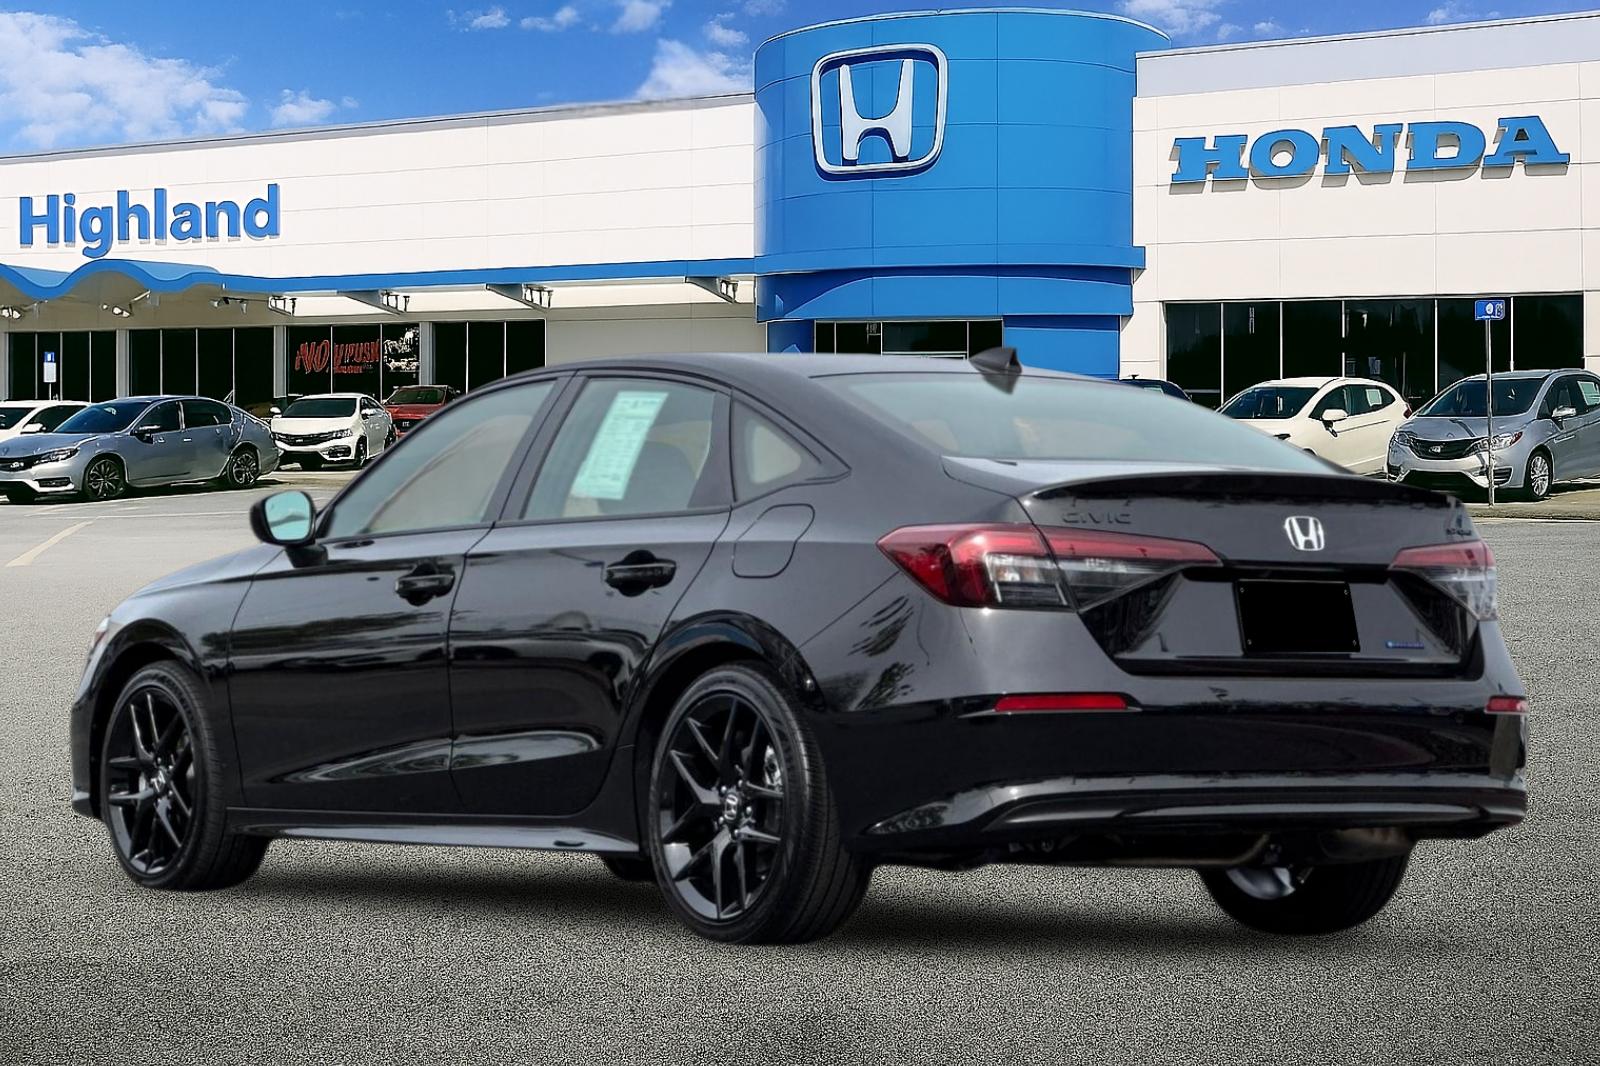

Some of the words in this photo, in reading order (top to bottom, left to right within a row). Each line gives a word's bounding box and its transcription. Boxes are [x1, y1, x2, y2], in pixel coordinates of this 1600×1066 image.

[1171, 115, 1570, 185] HONDA
[20, 183, 281, 259] Highland
[1061, 511, 1133, 525] CIVIC
